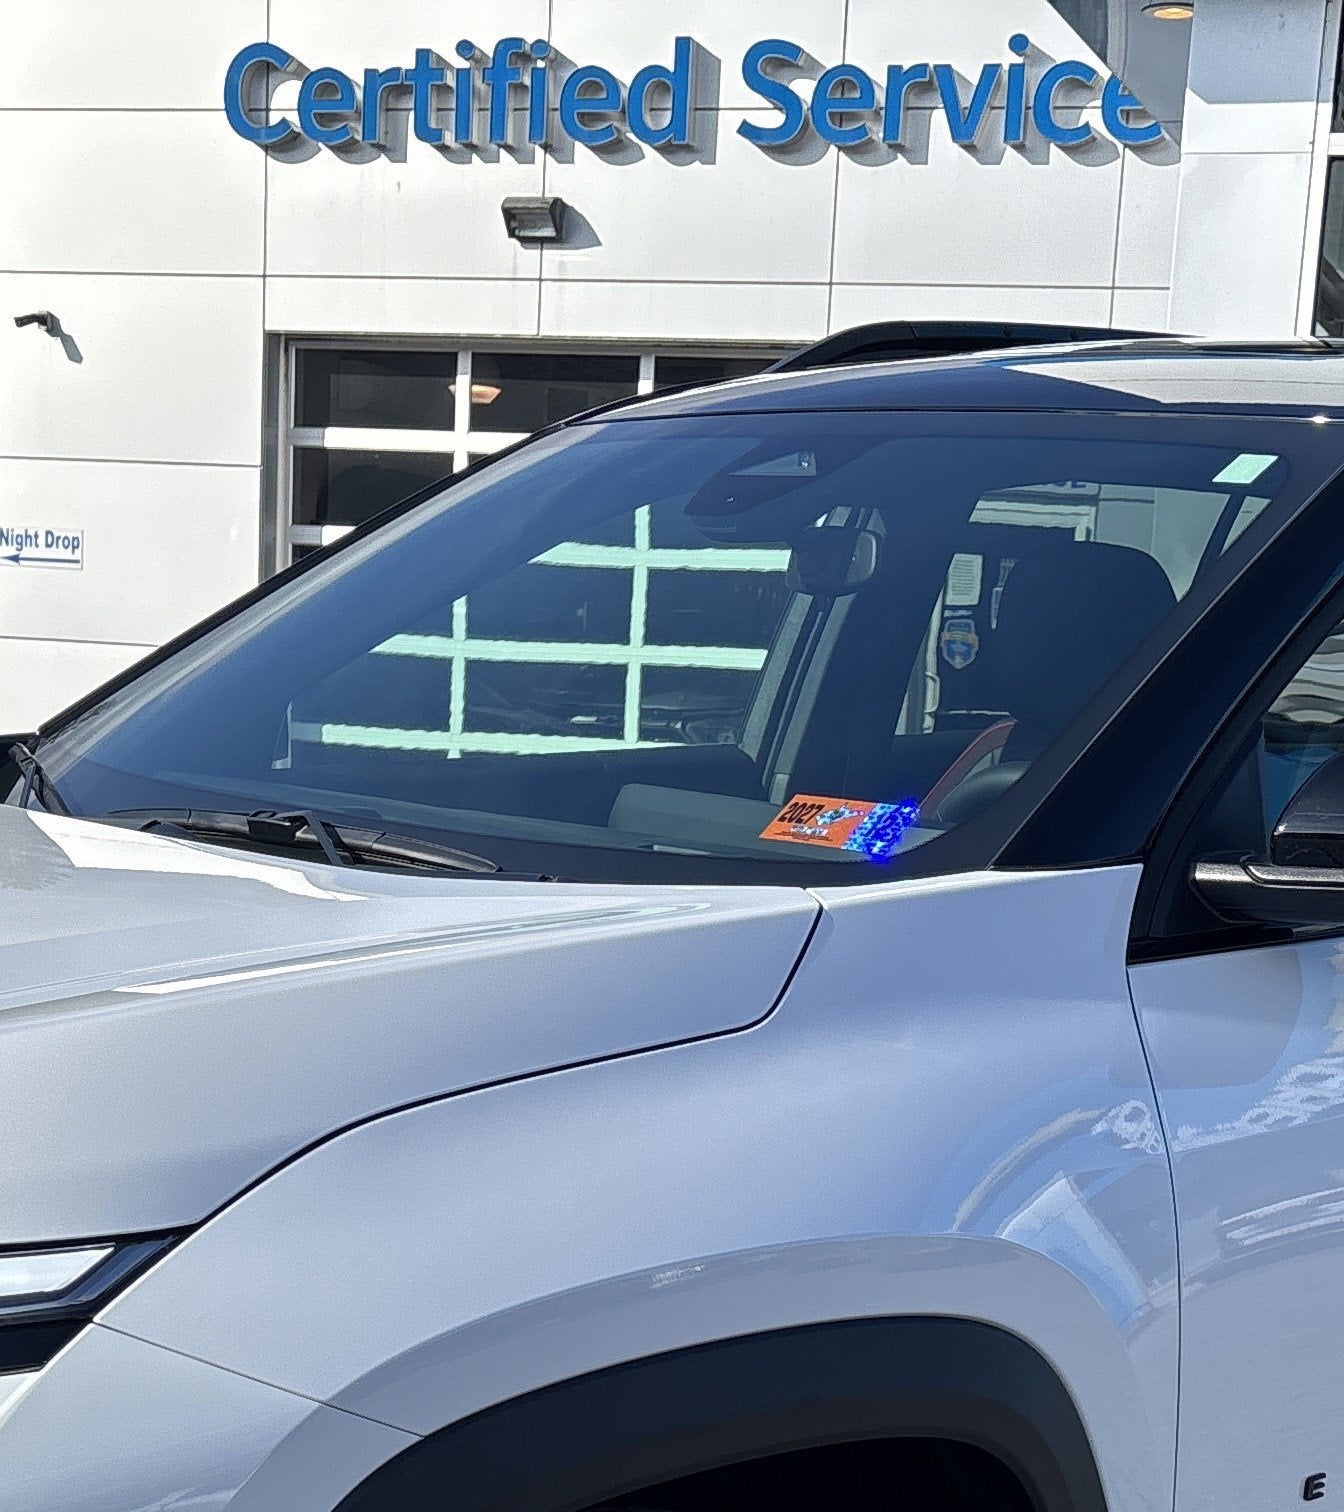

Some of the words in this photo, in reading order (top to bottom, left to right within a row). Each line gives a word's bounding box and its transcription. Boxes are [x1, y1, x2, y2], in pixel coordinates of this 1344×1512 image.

[224, 36, 692, 145] Certified
[738, 33, 1163, 146] Service
[0, 527, 39, 552] Night
[45, 529, 80, 555] Drop
[777, 802, 825, 824] 2027
